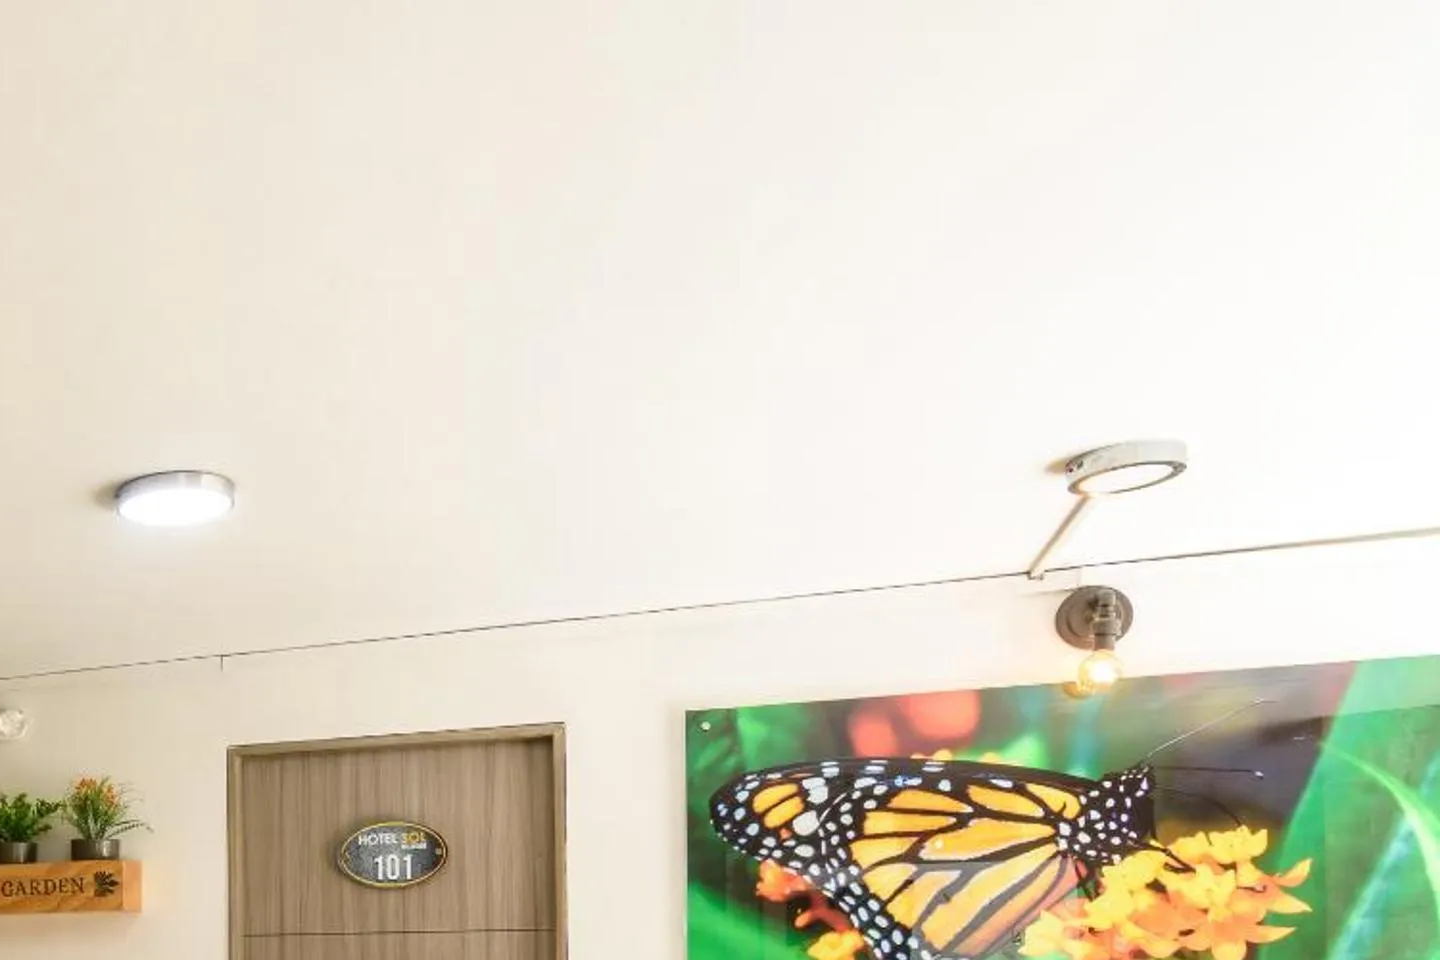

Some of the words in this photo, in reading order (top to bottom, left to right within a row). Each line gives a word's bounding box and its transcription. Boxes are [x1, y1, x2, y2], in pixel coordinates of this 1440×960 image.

[358, 832, 398, 845] HOTEL
[374, 854, 412, 880] 101
[1, 877, 85, 898] GARDEN
